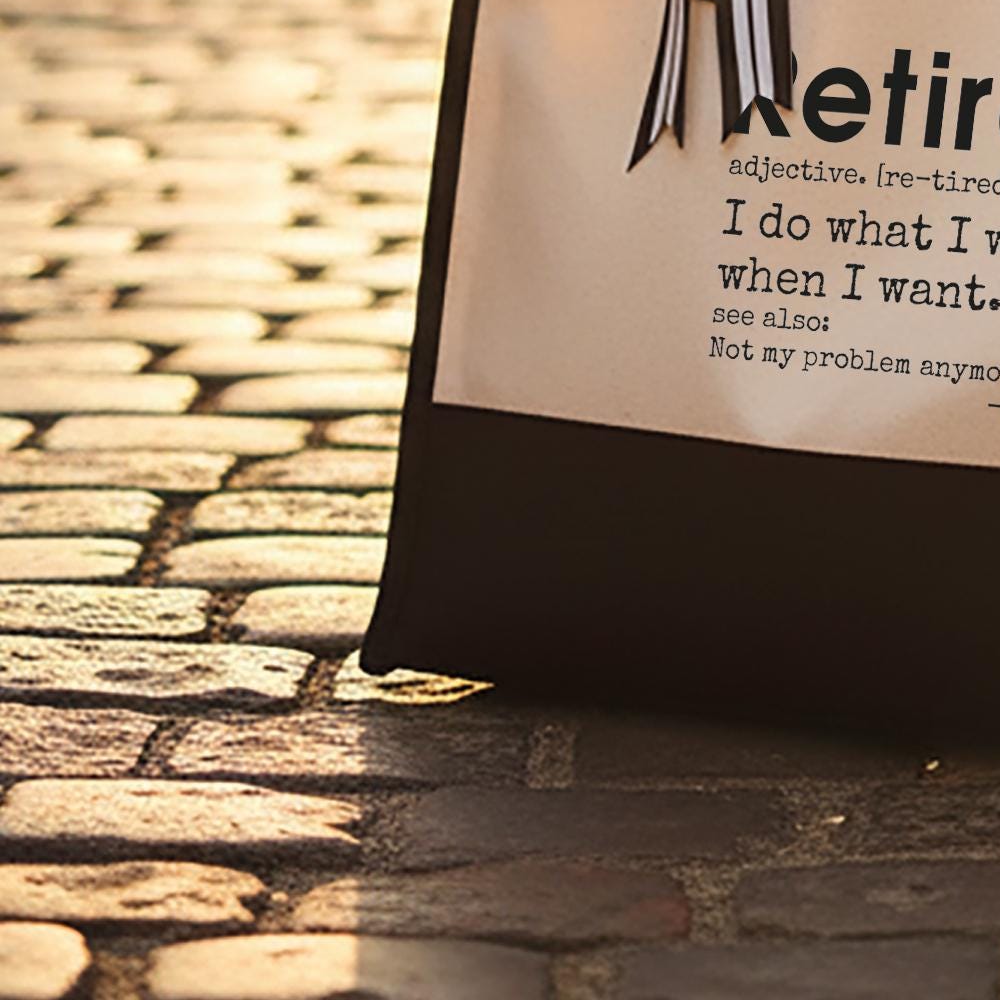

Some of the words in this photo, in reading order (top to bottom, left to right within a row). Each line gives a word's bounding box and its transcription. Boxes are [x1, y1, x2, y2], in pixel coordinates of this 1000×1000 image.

[729, 156, 866, 184] adjective.
[722, 199, 746, 236] I
[759, 203, 811, 241] do
[826, 210, 933, 251] what
[947, 216, 972, 253] I
[718, 257, 827, 298] when
[841, 263, 866, 301] I
[879, 274, 1000, 311] want.
[712, 307, 754, 326] see
[762, 308, 830, 332] also:
[708, 335, 754, 361] Not
[762, 347, 796, 369] my
[801, 349, 911, 374] problem
